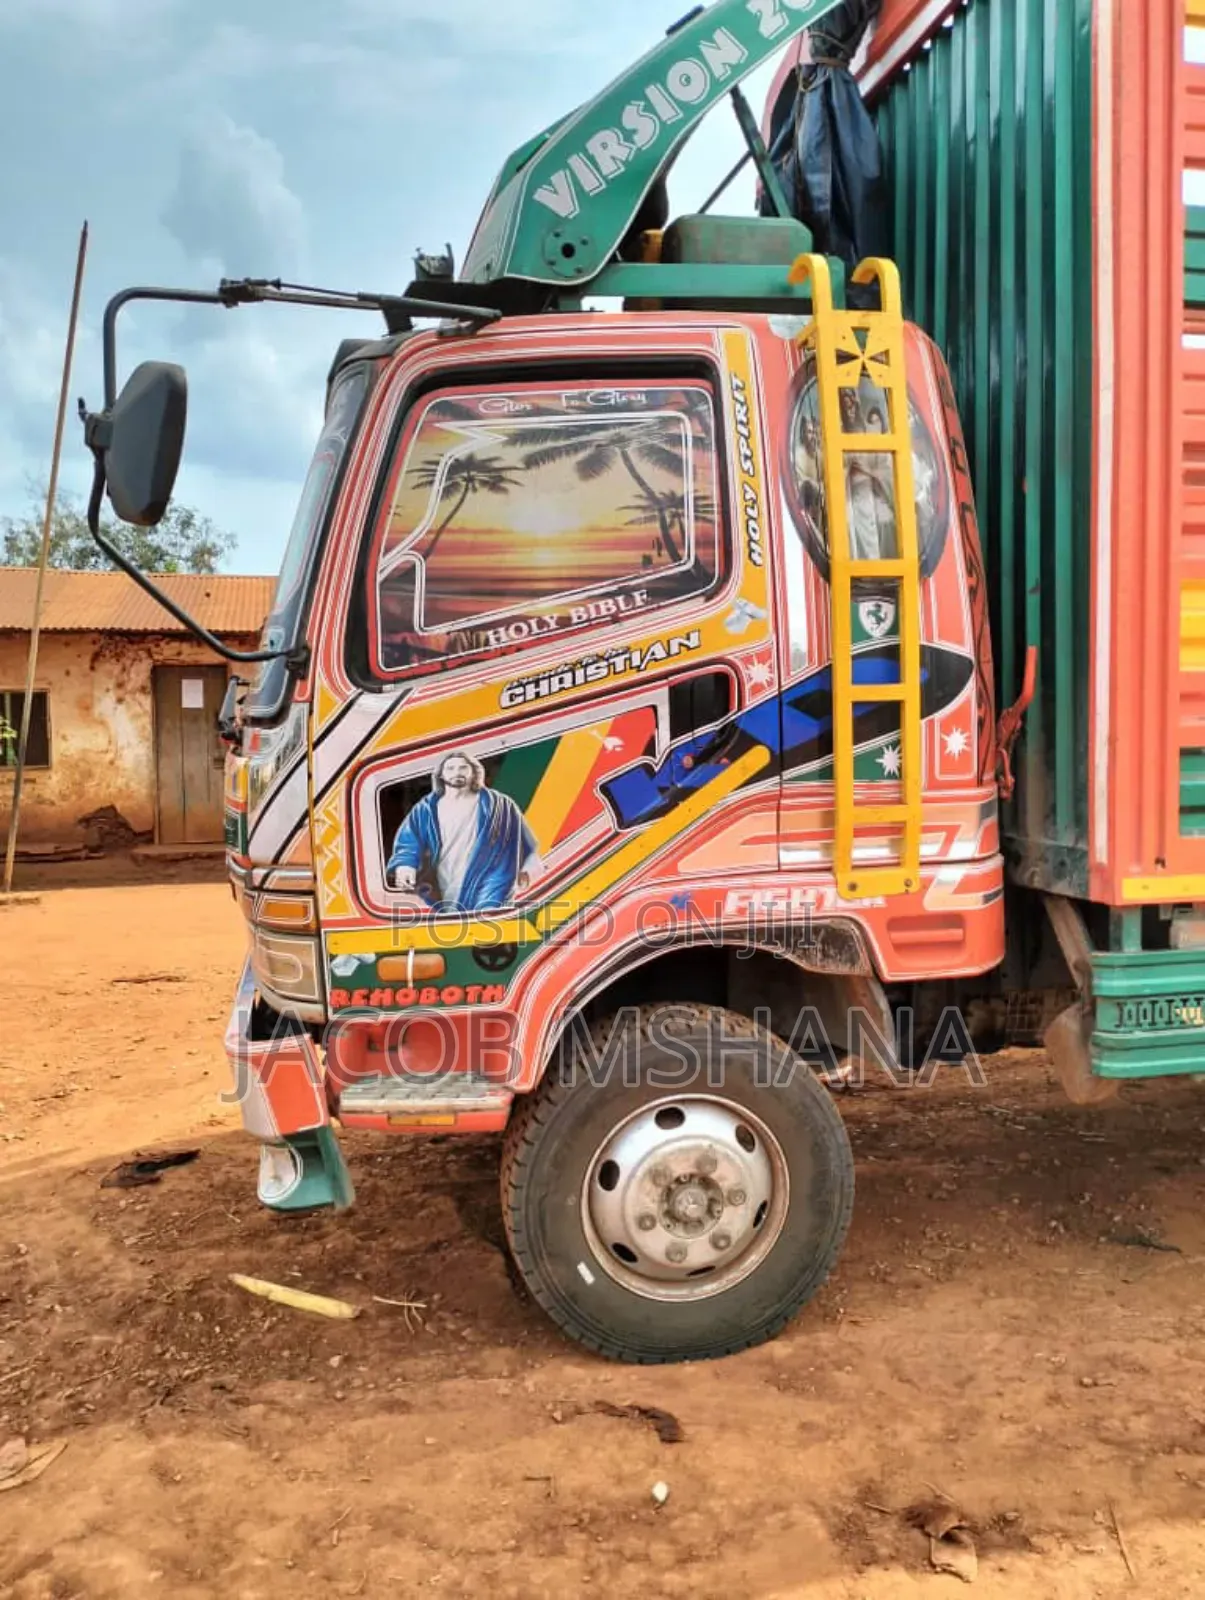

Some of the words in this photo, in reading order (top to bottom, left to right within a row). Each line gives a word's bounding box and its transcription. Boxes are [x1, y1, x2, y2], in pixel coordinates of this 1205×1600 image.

[533, 26, 749, 219] VIRSION
[730, 371, 755, 478] SPIRIT
[741, 481, 763, 568] HOLY
[486, 612, 562, 646] HOLY
[568, 588, 650, 624] BIBLE
[500, 629, 701, 710] CHRISTIAN
[329, 984, 506, 1009] REHOBOTH
